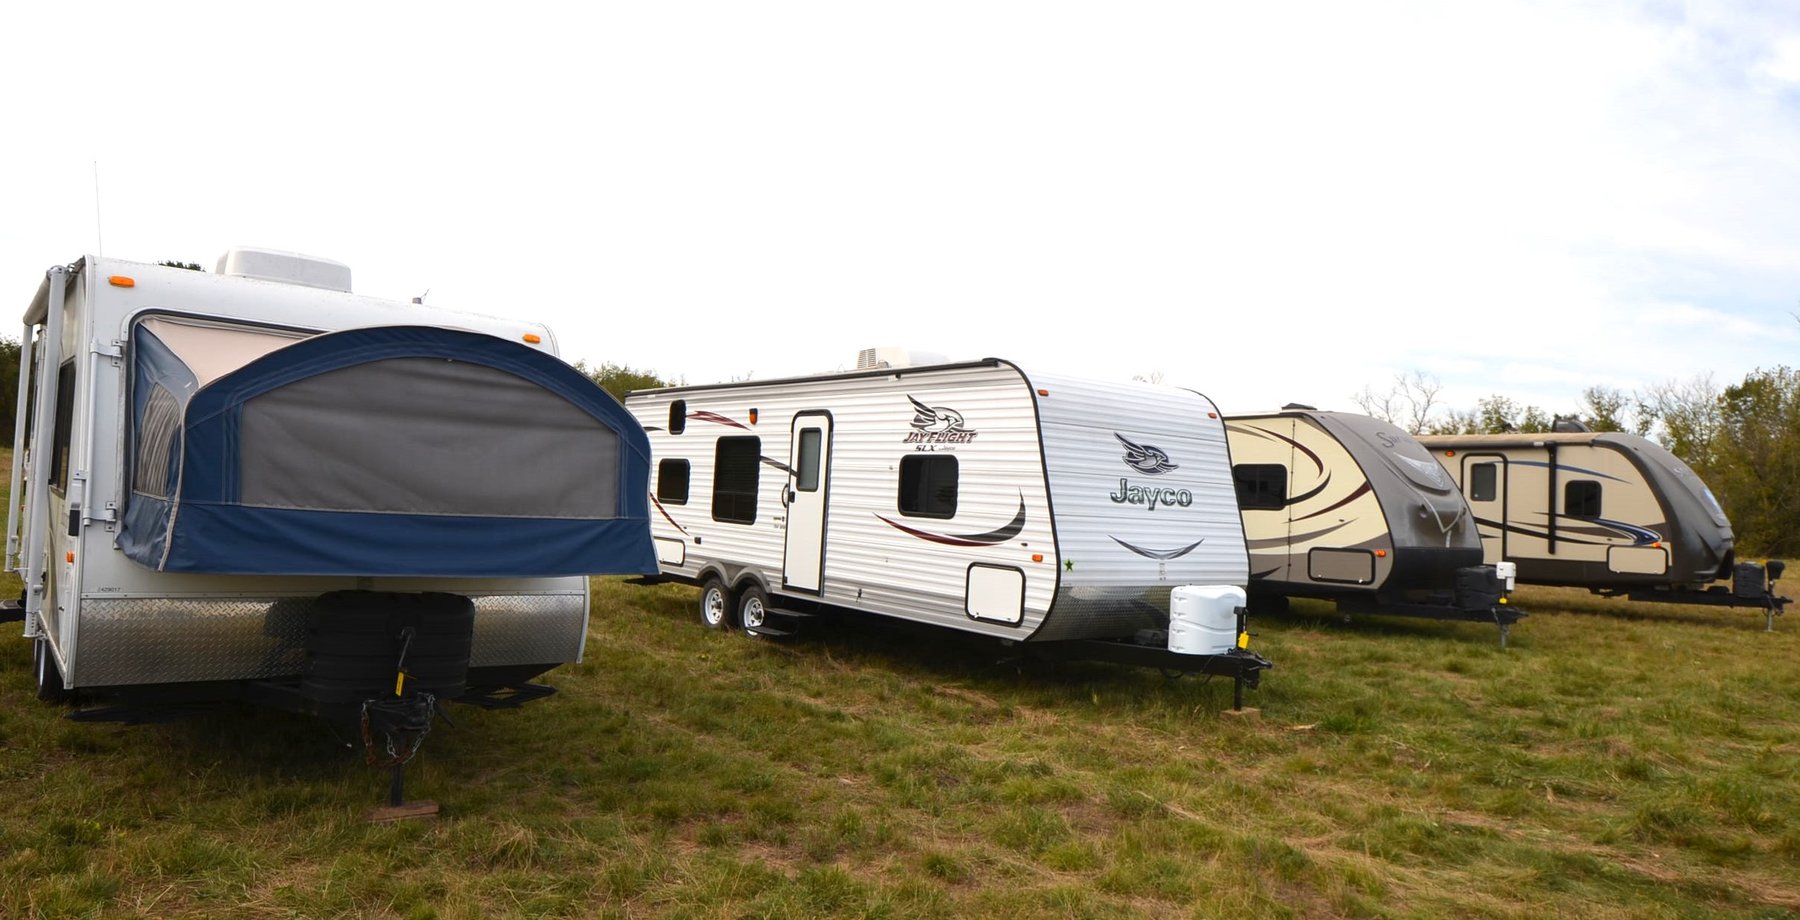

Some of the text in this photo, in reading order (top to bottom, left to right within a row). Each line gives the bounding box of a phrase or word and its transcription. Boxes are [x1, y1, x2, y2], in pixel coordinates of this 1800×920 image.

[903, 432, 977, 443] JAY FLIGHT
[1110, 478, 1193, 511] Jayco
